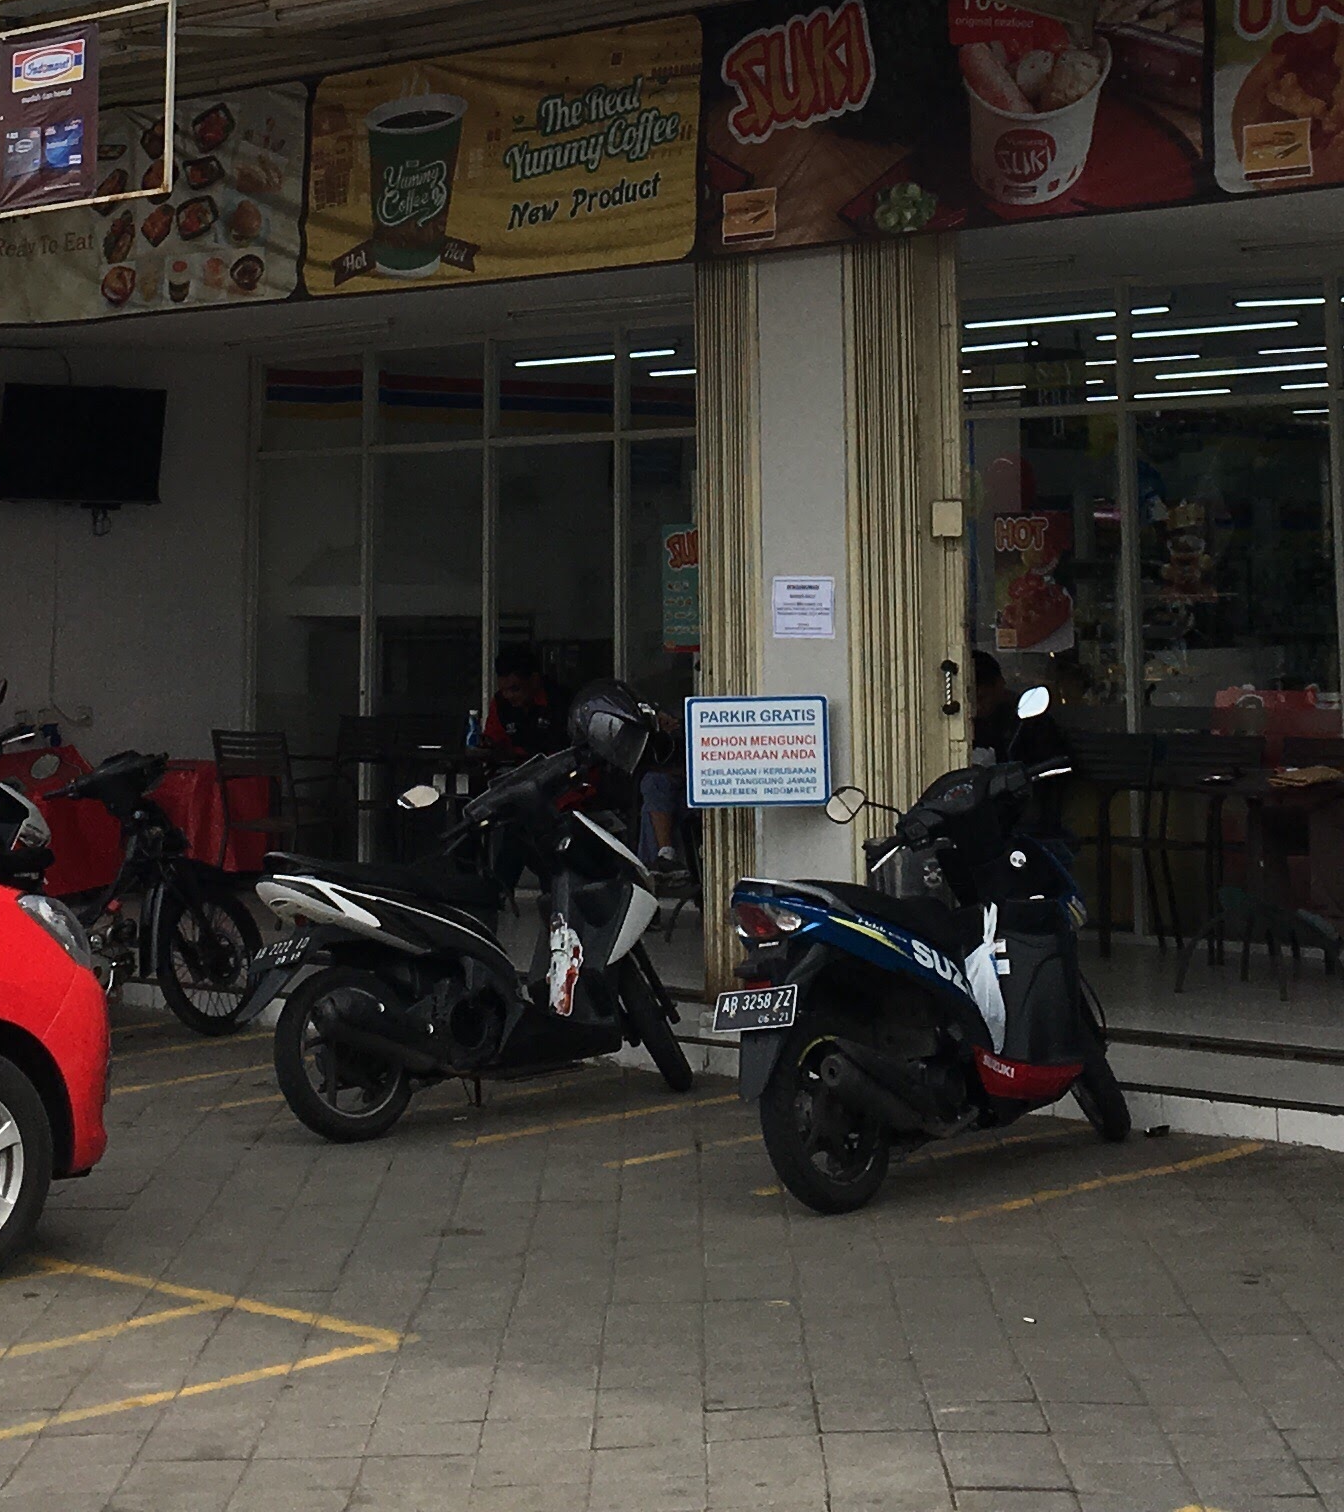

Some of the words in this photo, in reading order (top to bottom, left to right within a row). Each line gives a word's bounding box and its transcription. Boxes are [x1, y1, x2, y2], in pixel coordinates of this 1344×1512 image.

[954, 15, 993, 29] original
[540, 96, 582, 134] The
[586, 76, 643, 121] Real
[505, 133, 605, 181] Yummy
[606, 109, 680, 161] Coffee
[383, 164, 440, 189] Yummy
[382, 187, 429, 219] Coffee
[507, 200, 559, 231] New
[569, 171, 662, 218] Product
[40, 234, 58, 255] To
[63, 231, 94, 252] Eat
[995, 518, 1049, 551] HOT
[699, 710, 756, 724] PARKIR
[759, 709, 816, 723] GRATIS
[700, 736, 748, 748] MOHON
[750, 734, 817, 746] MENGUNCI
[700, 749, 779, 762] KENDARAAN
[781, 748, 817, 760] ANDA
[735, 777, 785, 786] TANGGUNG
[786, 776, 818, 786] JAWAB
[762, 767, 818, 777] KERUSAKAN
[700, 787, 758, 796] MANAJEMEN
[763, 786, 818, 796] INDOMARET
[910, 938, 974, 1000] SUZ
[721, 996, 739, 1013] AB
[741, 992, 772, 1011] 3258
[773, 989, 792, 1008] ZZ
[982, 1054, 1016, 1079] SUZUKI
